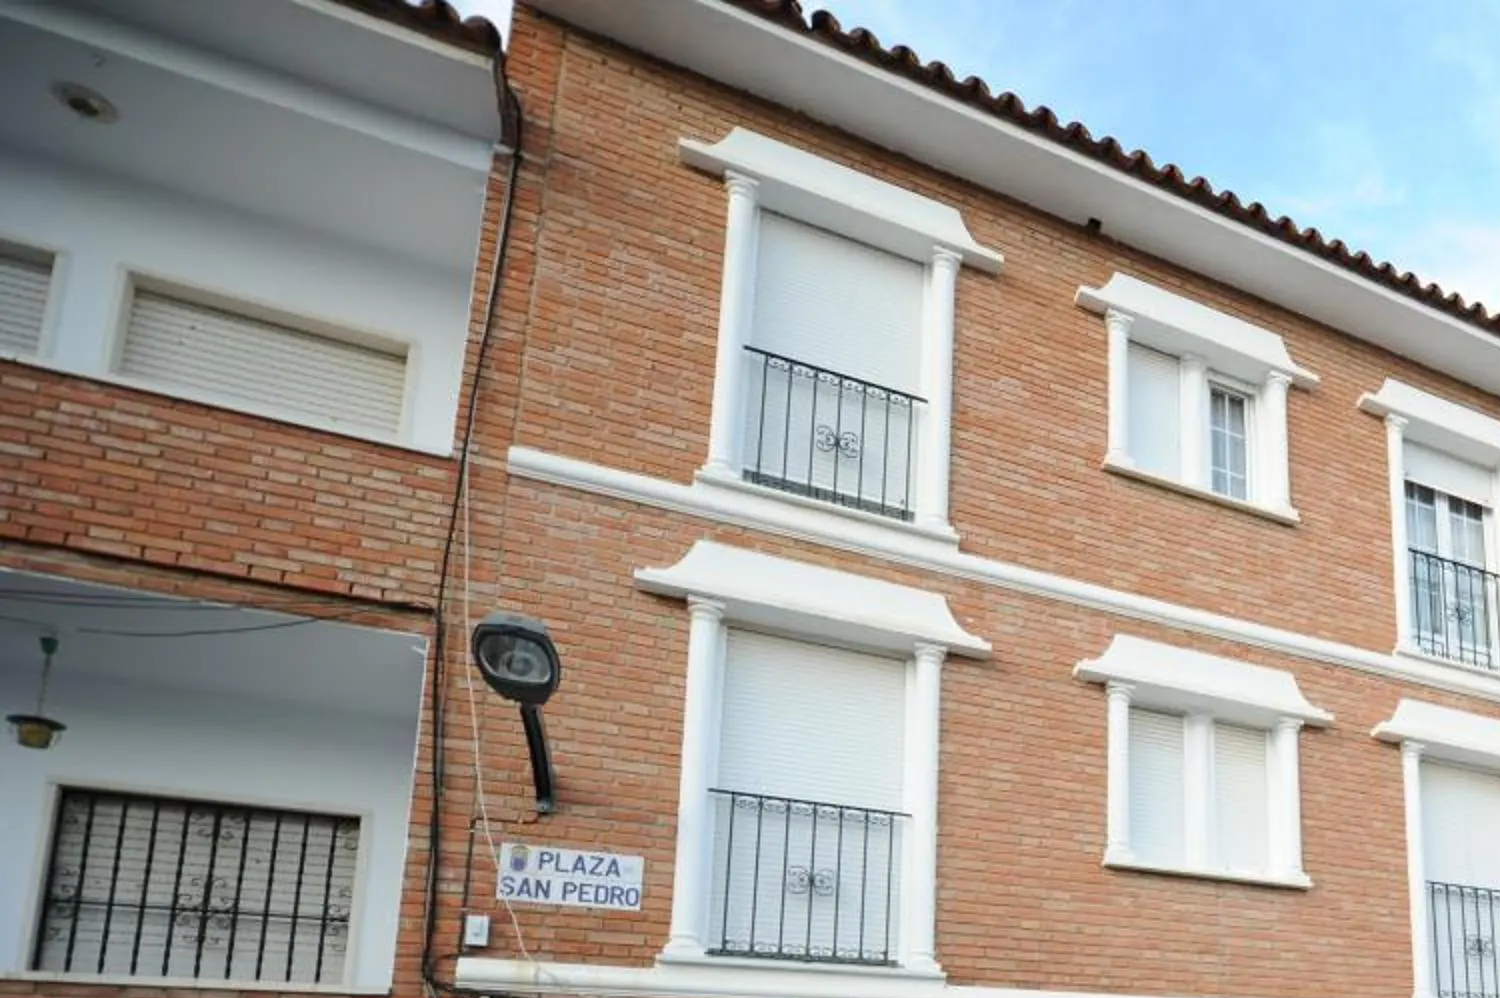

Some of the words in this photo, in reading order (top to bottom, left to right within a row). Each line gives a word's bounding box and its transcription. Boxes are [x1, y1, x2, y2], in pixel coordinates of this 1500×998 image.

[538, 851, 622, 877] PLAZA
[499, 876, 551, 900] SAN
[561, 881, 640, 907] PEDRO
